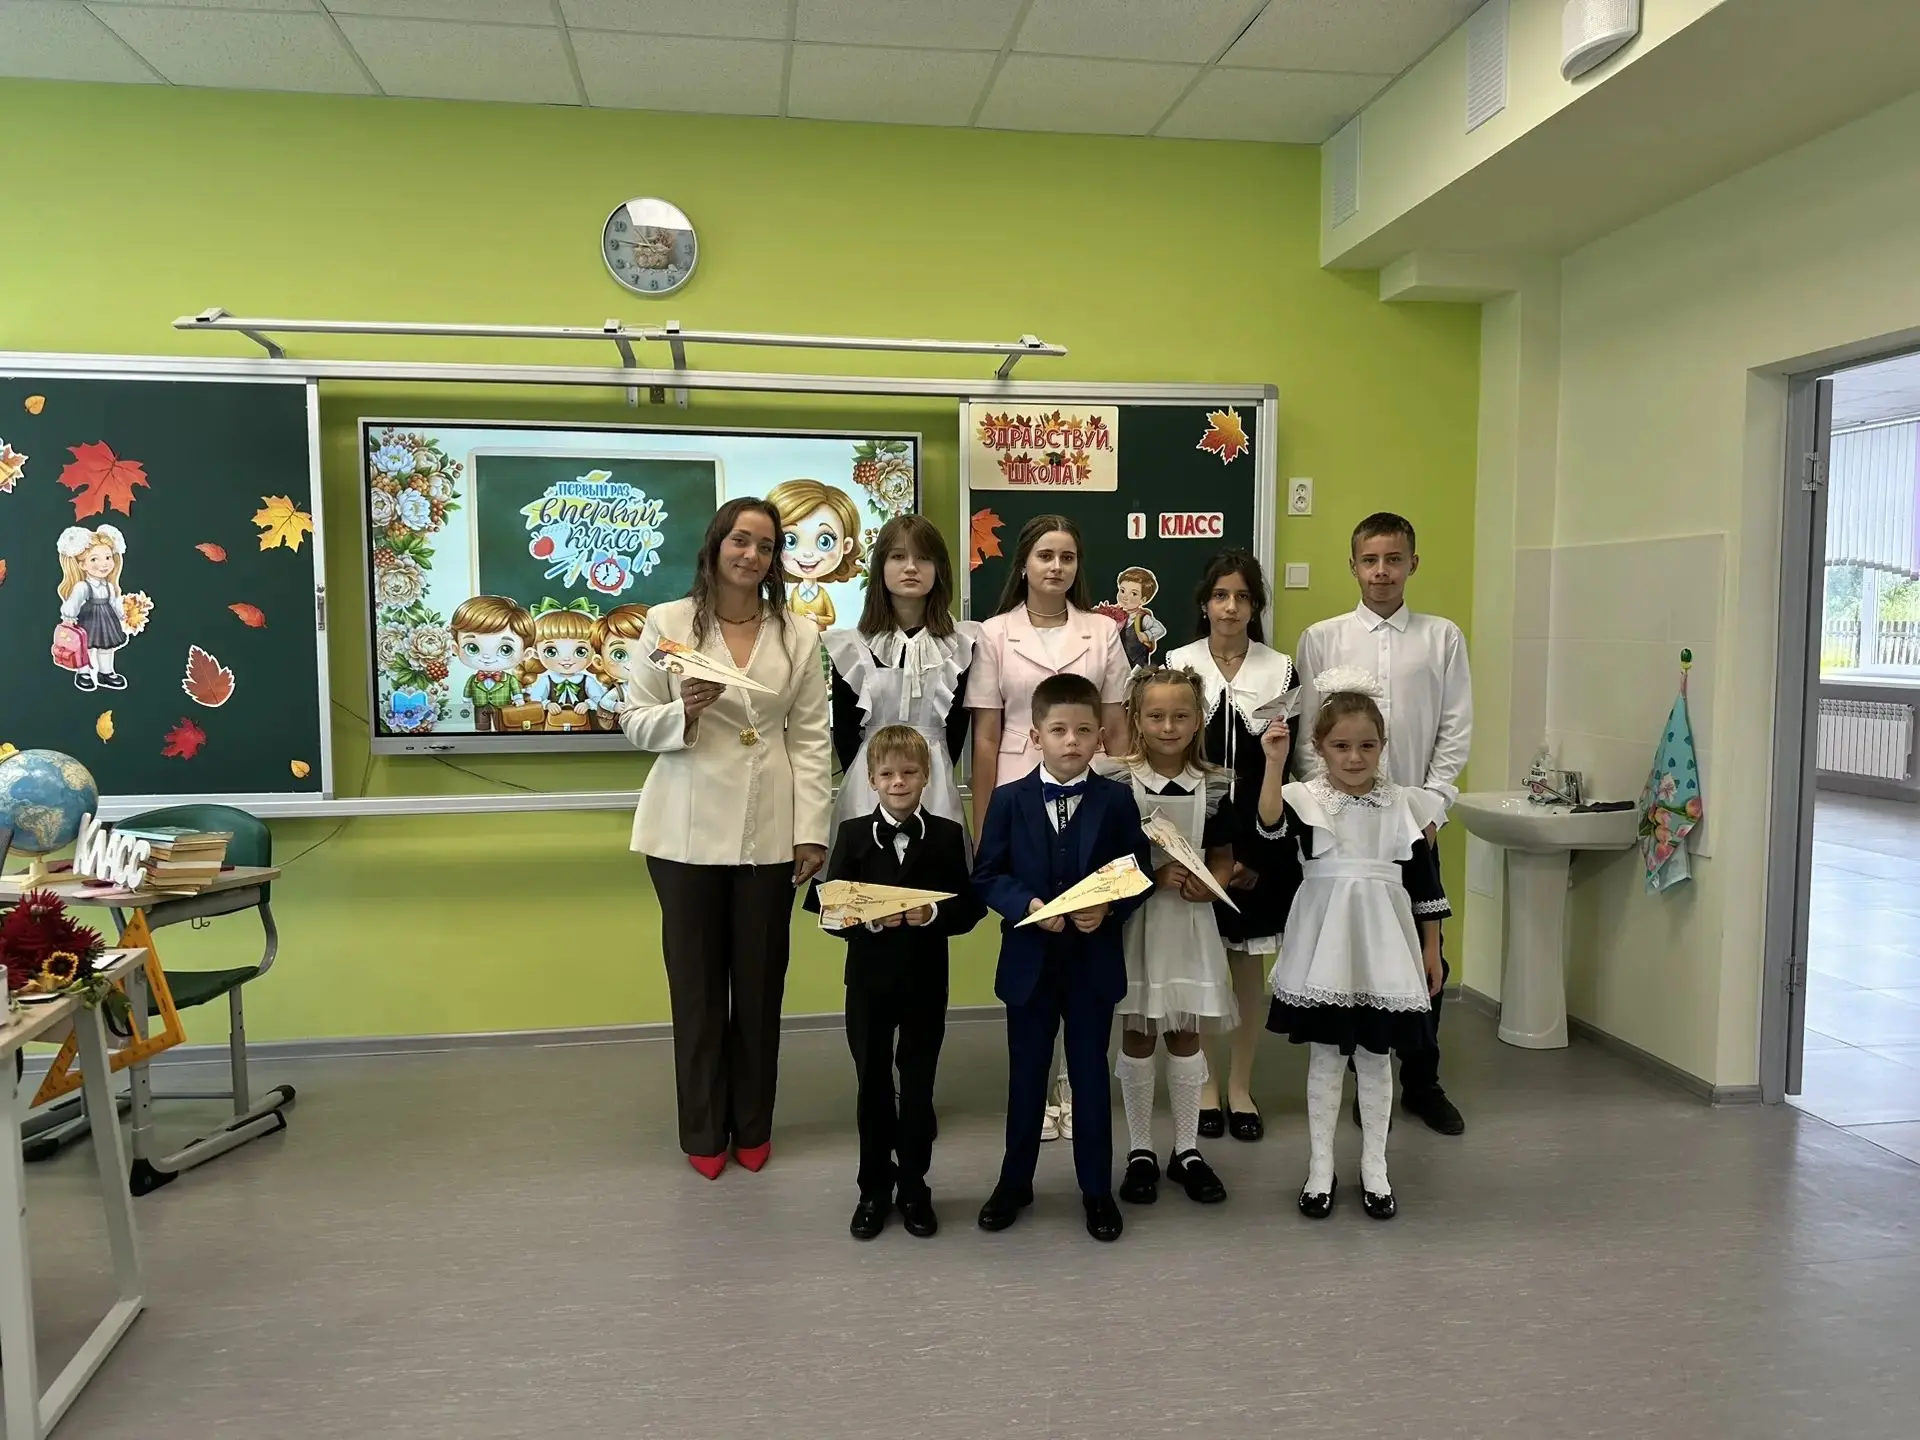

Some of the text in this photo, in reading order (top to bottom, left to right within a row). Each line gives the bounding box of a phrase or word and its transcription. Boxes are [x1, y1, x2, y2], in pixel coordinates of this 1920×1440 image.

[983, 423, 1114, 452] ЗДРАВСТВУЙ,
[1008, 461, 1083, 485] ШКОЛА!
[557, 482, 630, 497] ПЕРВЫЙ РАЗ
[1132, 515, 1222, 537] 1 КЛАСС
